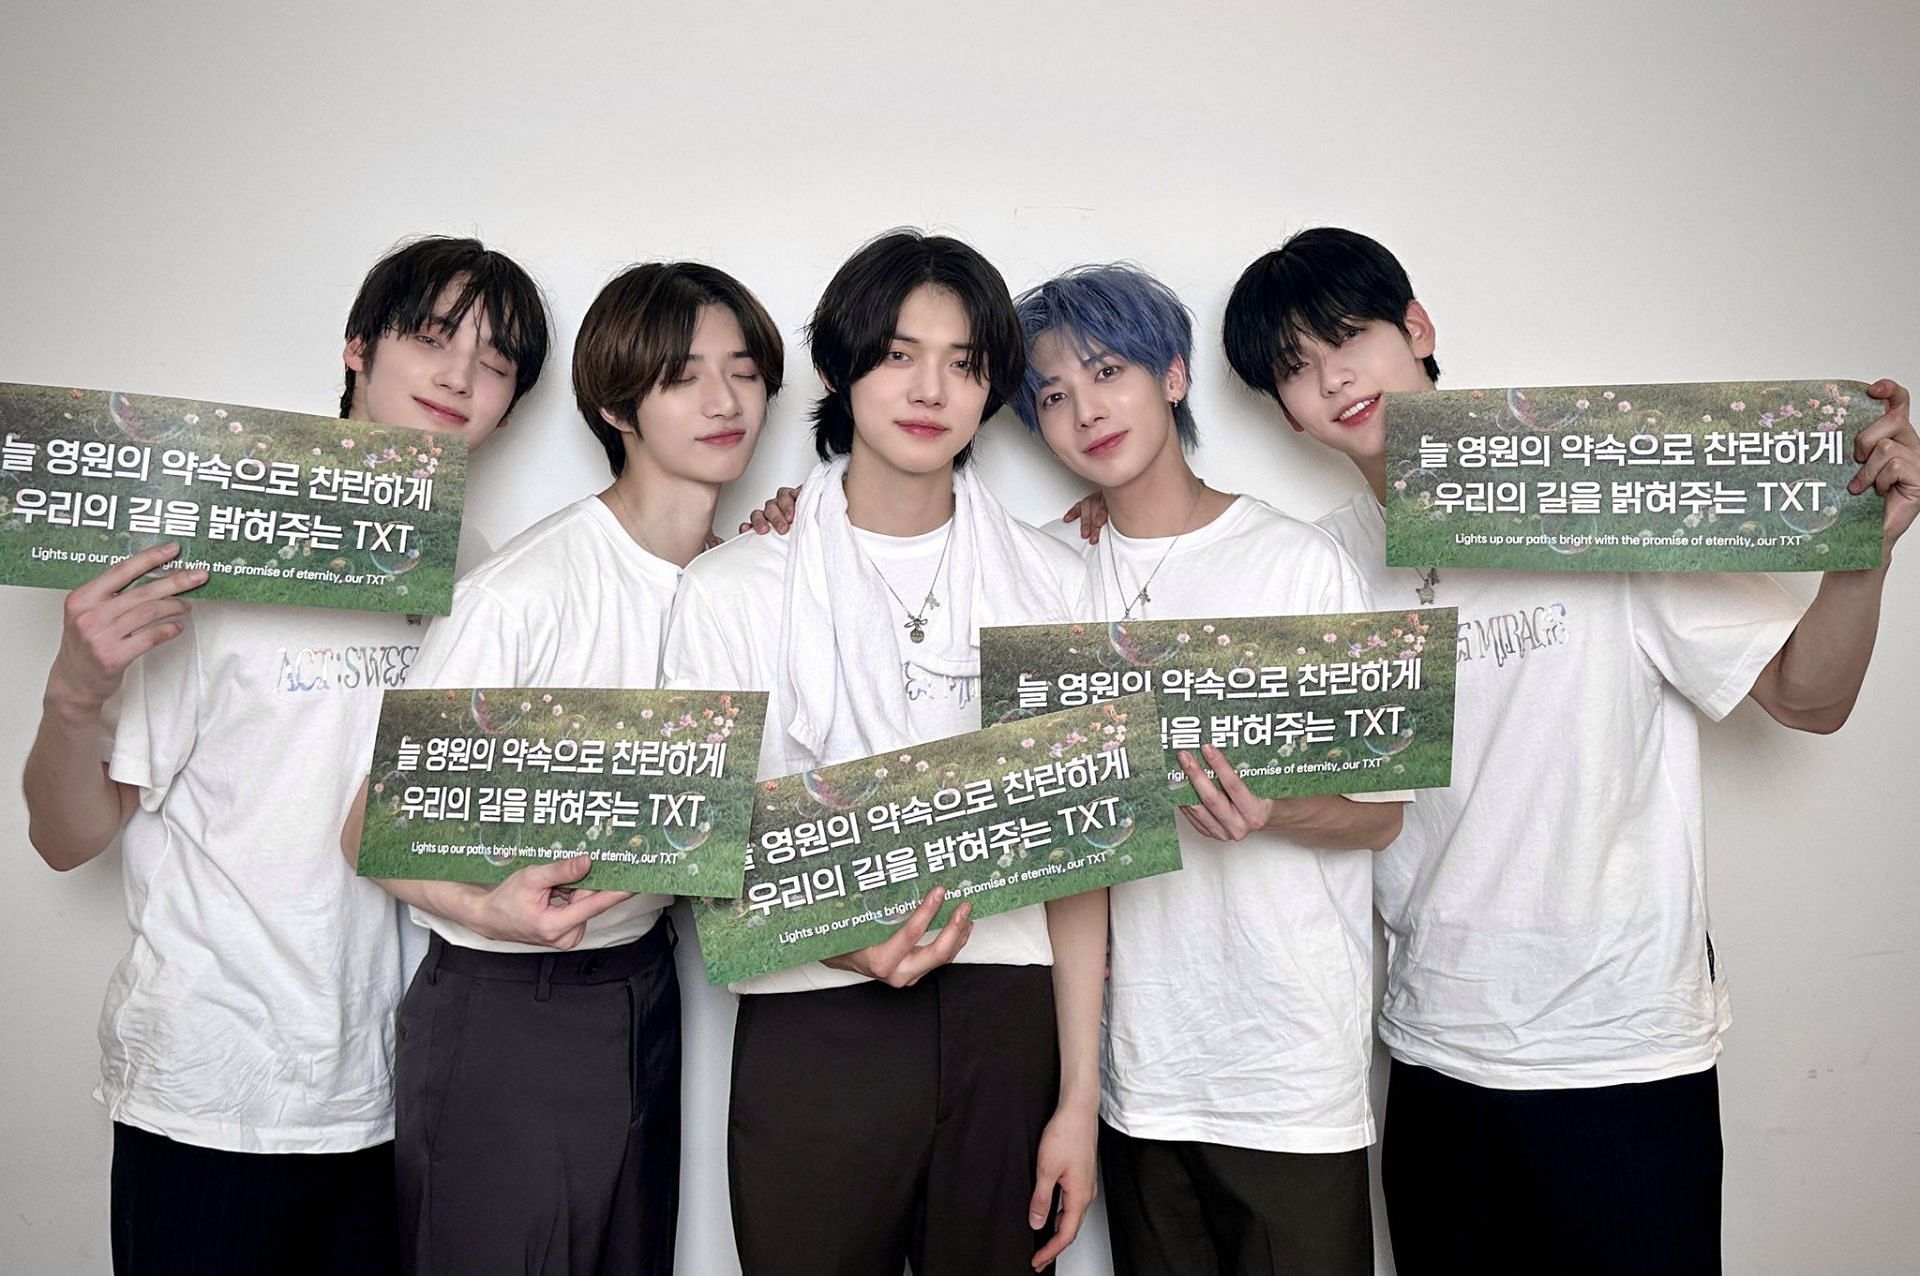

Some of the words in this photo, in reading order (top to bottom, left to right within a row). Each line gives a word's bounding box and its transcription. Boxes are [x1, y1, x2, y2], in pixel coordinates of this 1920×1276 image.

[1418, 436, 1449, 468] 늘
[1458, 434, 1550, 468] 영원의
[1561, 433, 1696, 468] 약속으로
[1703, 430, 1844, 466] 찬란하게
[2, 435, 37, 472] 늘
[46, 438, 151, 482] 영원의
[161, 450, 300, 497] 약속으로
[308, 465, 433, 511] 찬란하게
[1434, 481, 1526, 514] 우리의
[1536, 481, 1602, 514] 길을
[1612, 481, 1748, 514] 밝혀주는
[1757, 481, 1827, 512] TXT
[12, 489, 116, 530] 우리의
[127, 495, 200, 537] 길을
[207, 505, 343, 550] 밝혀주는
[352, 520, 414, 553] TXT
[1455, 533, 1487, 545] Lights
[1489, 535, 1503, 545] up
[1505, 535, 1524, 544] our
[1526, 534, 1557, 545] paths
[1559, 534, 1592, 546] bright
[1594, 534, 1619, 544] with
[1621, 535, 1640, 545] the
[1642, 535, 1689, 546] promise
[1690, 535, 1703, 545] of
[1705, 535, 1755, 548] eternity,
[1757, 536, 1777, 545] our
[1779, 536, 1802, 545] TXT
[32, 547, 67, 561] Lights
[71, 553, 85, 564] up
[89, 554, 107, 564] our
[185, 560, 210, 571] with
[213, 562, 232, 573] the
[234, 564, 280, 577] promise
[282, 567, 295, 578] of
[297, 569, 343, 584] eternity,
[345, 574, 364, 584] our
[366, 574, 386, 585] TXT
[1017, 673, 1049, 708] 늘
[1162, 667, 1290, 701] 약속으로
[1297, 658, 1421, 697] 찬란하게
[1161, 716, 1201, 749] 을
[1210, 711, 1336, 748] 밝혀주는
[1344, 706, 1405, 737] TXT
[398, 736, 421, 772] 늘
[426, 737, 494, 773] 영원의
[501, 738, 605, 775] 약속으로
[611, 740, 727, 779] 찬란하게
[1240, 763, 1282, 779] promise
[1284, 763, 1295, 774] of
[1297, 761, 1341, 773] eternity,
[1342, 761, 1360, 770] our
[1363, 758, 1382, 769] TXT
[401, 786, 470, 822] 우리의
[478, 787, 528, 824] 길을
[532, 789, 639, 828] 밝혀주는
[649, 793, 706, 828] TXT
[761, 812, 861, 865] 영원의
[866, 780, 998, 834] 약속으로
[1002, 747, 1131, 806] 찬란하게
[411, 841, 436, 854] Lights
[437, 843, 449, 855] up
[450, 845, 465, 854] our
[466, 845, 491, 856] paths
[493, 845, 517, 857] bright
[519, 846, 536, 857] with
[538, 848, 552, 858] the
[590, 849, 600, 860] of
[602, 850, 640, 865] eternity,
[641, 854, 658, 864] our
[660, 852, 679, 865] TXT
[749, 864, 846, 916] 우리의
[852, 848, 919, 889] 길을
[925, 815, 1053, 873] 밝혀주는
[1057, 797, 1121, 838] TXT
[779, 926, 813, 944] Lights
[815, 924, 829, 935] up
[831, 918, 850, 931] our
[852, 909, 883, 927] paths
[884, 900, 917, 917] bright
[963, 878, 1006, 898] promise
[1008, 873, 1019, 885] of
[1021, 863, 1066, 881] eternity,
[1067, 858, 1084, 870] our
[1086, 852, 1107, 865] TXT
